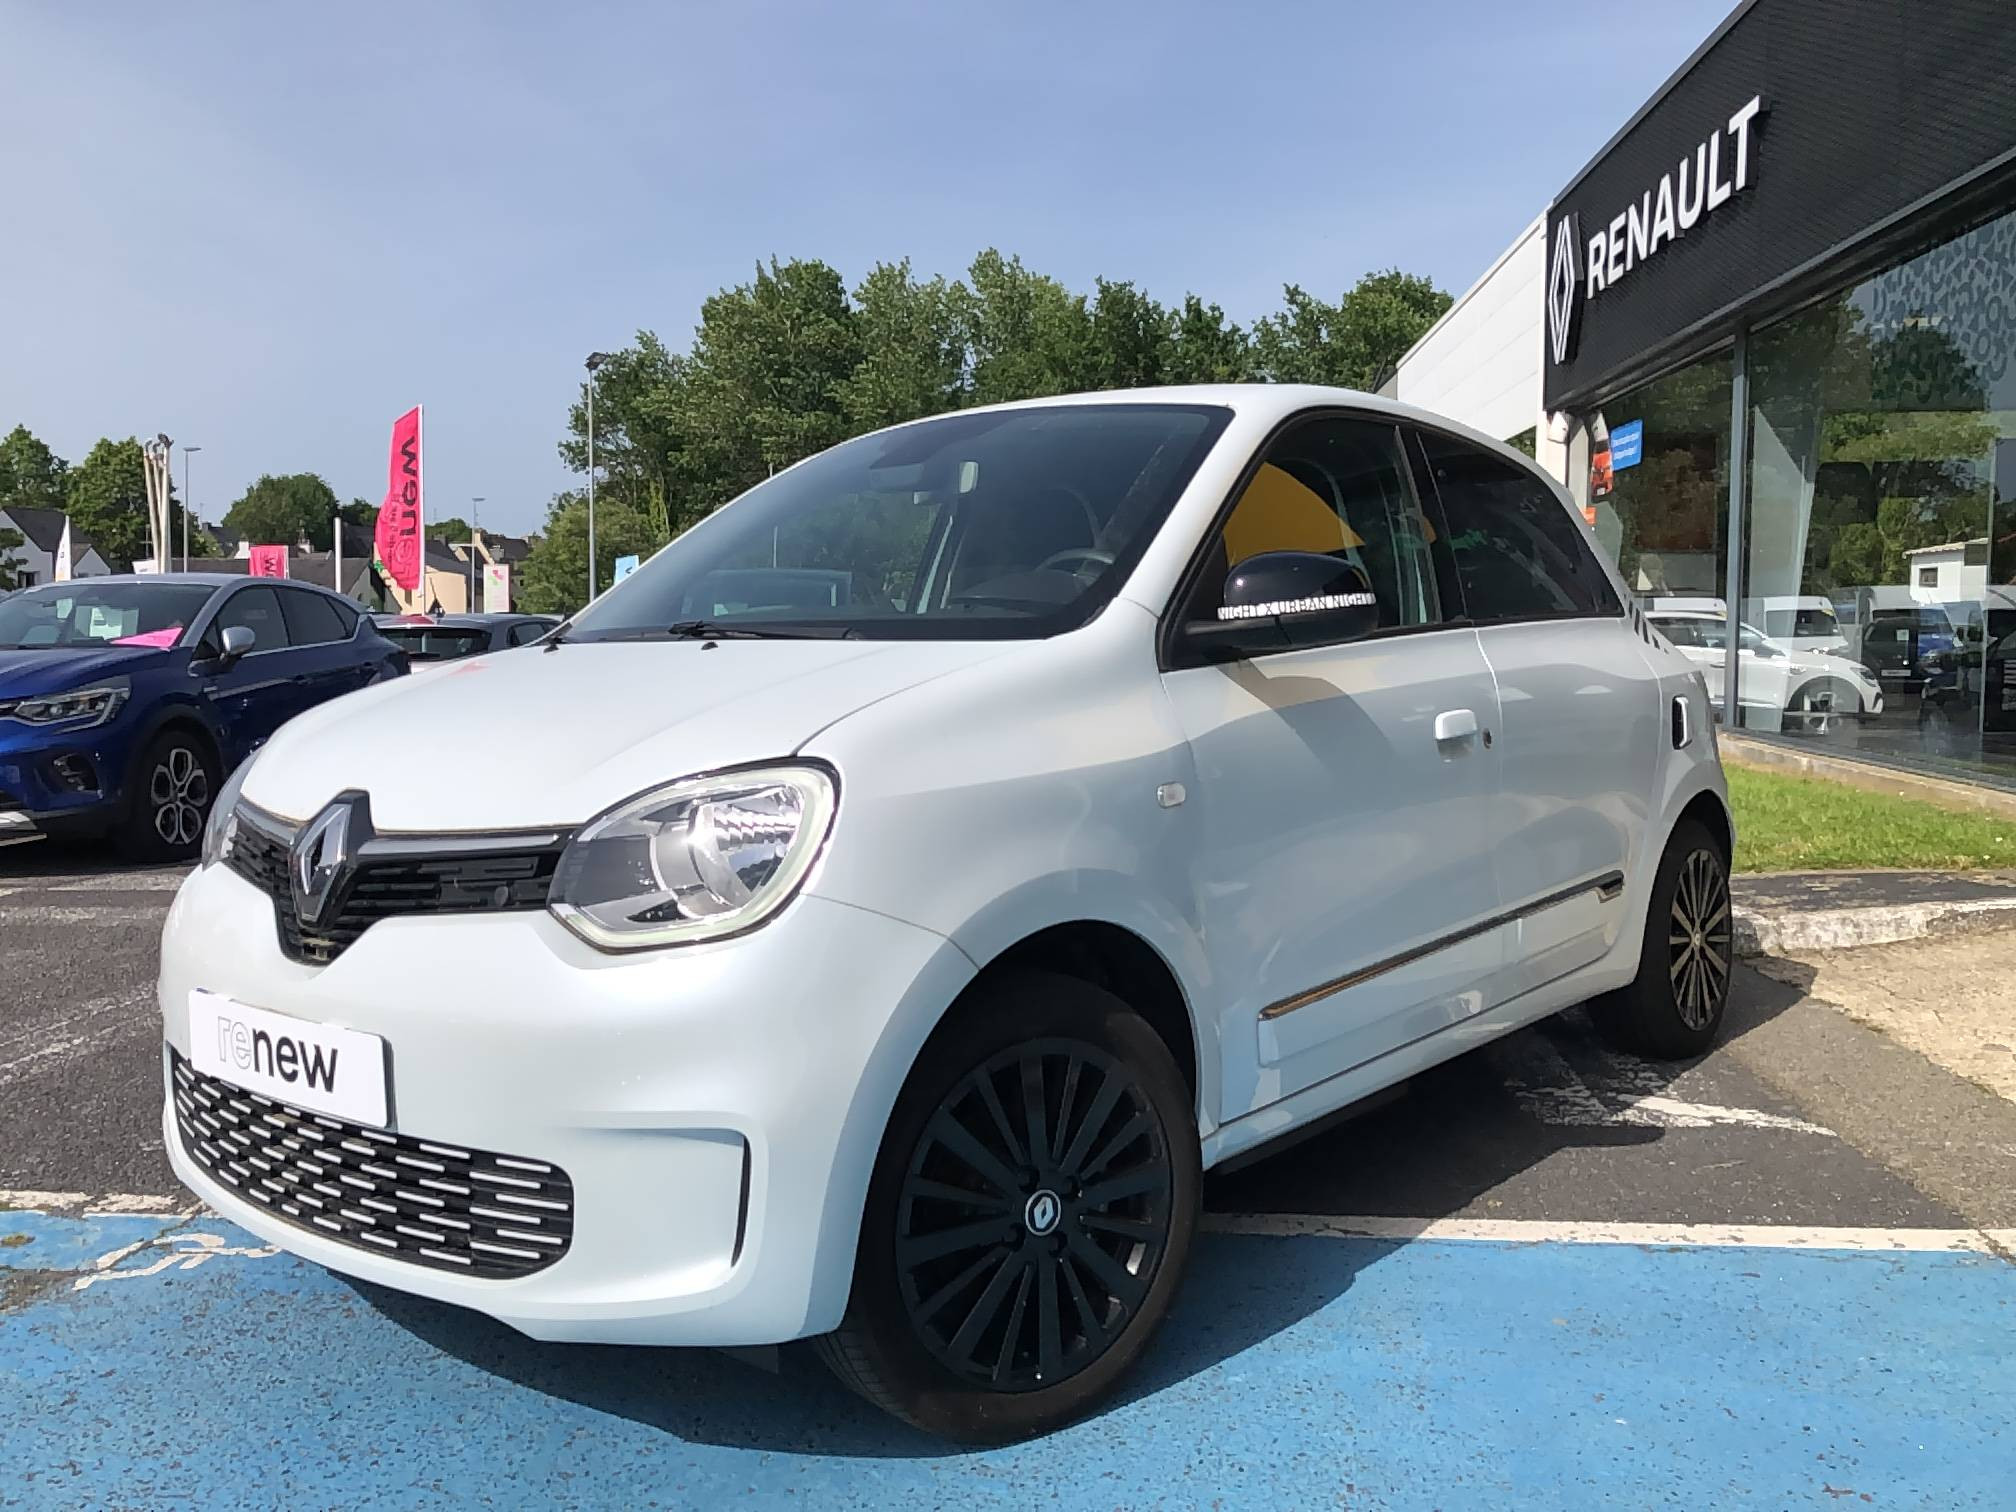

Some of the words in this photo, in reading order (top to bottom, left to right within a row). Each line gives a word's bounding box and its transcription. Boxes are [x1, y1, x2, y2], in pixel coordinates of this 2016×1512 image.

[1587, 95, 1759, 299] RENAULT
[1278, 598, 1326, 614] URBAN
[218, 1016, 338, 1093] renew
